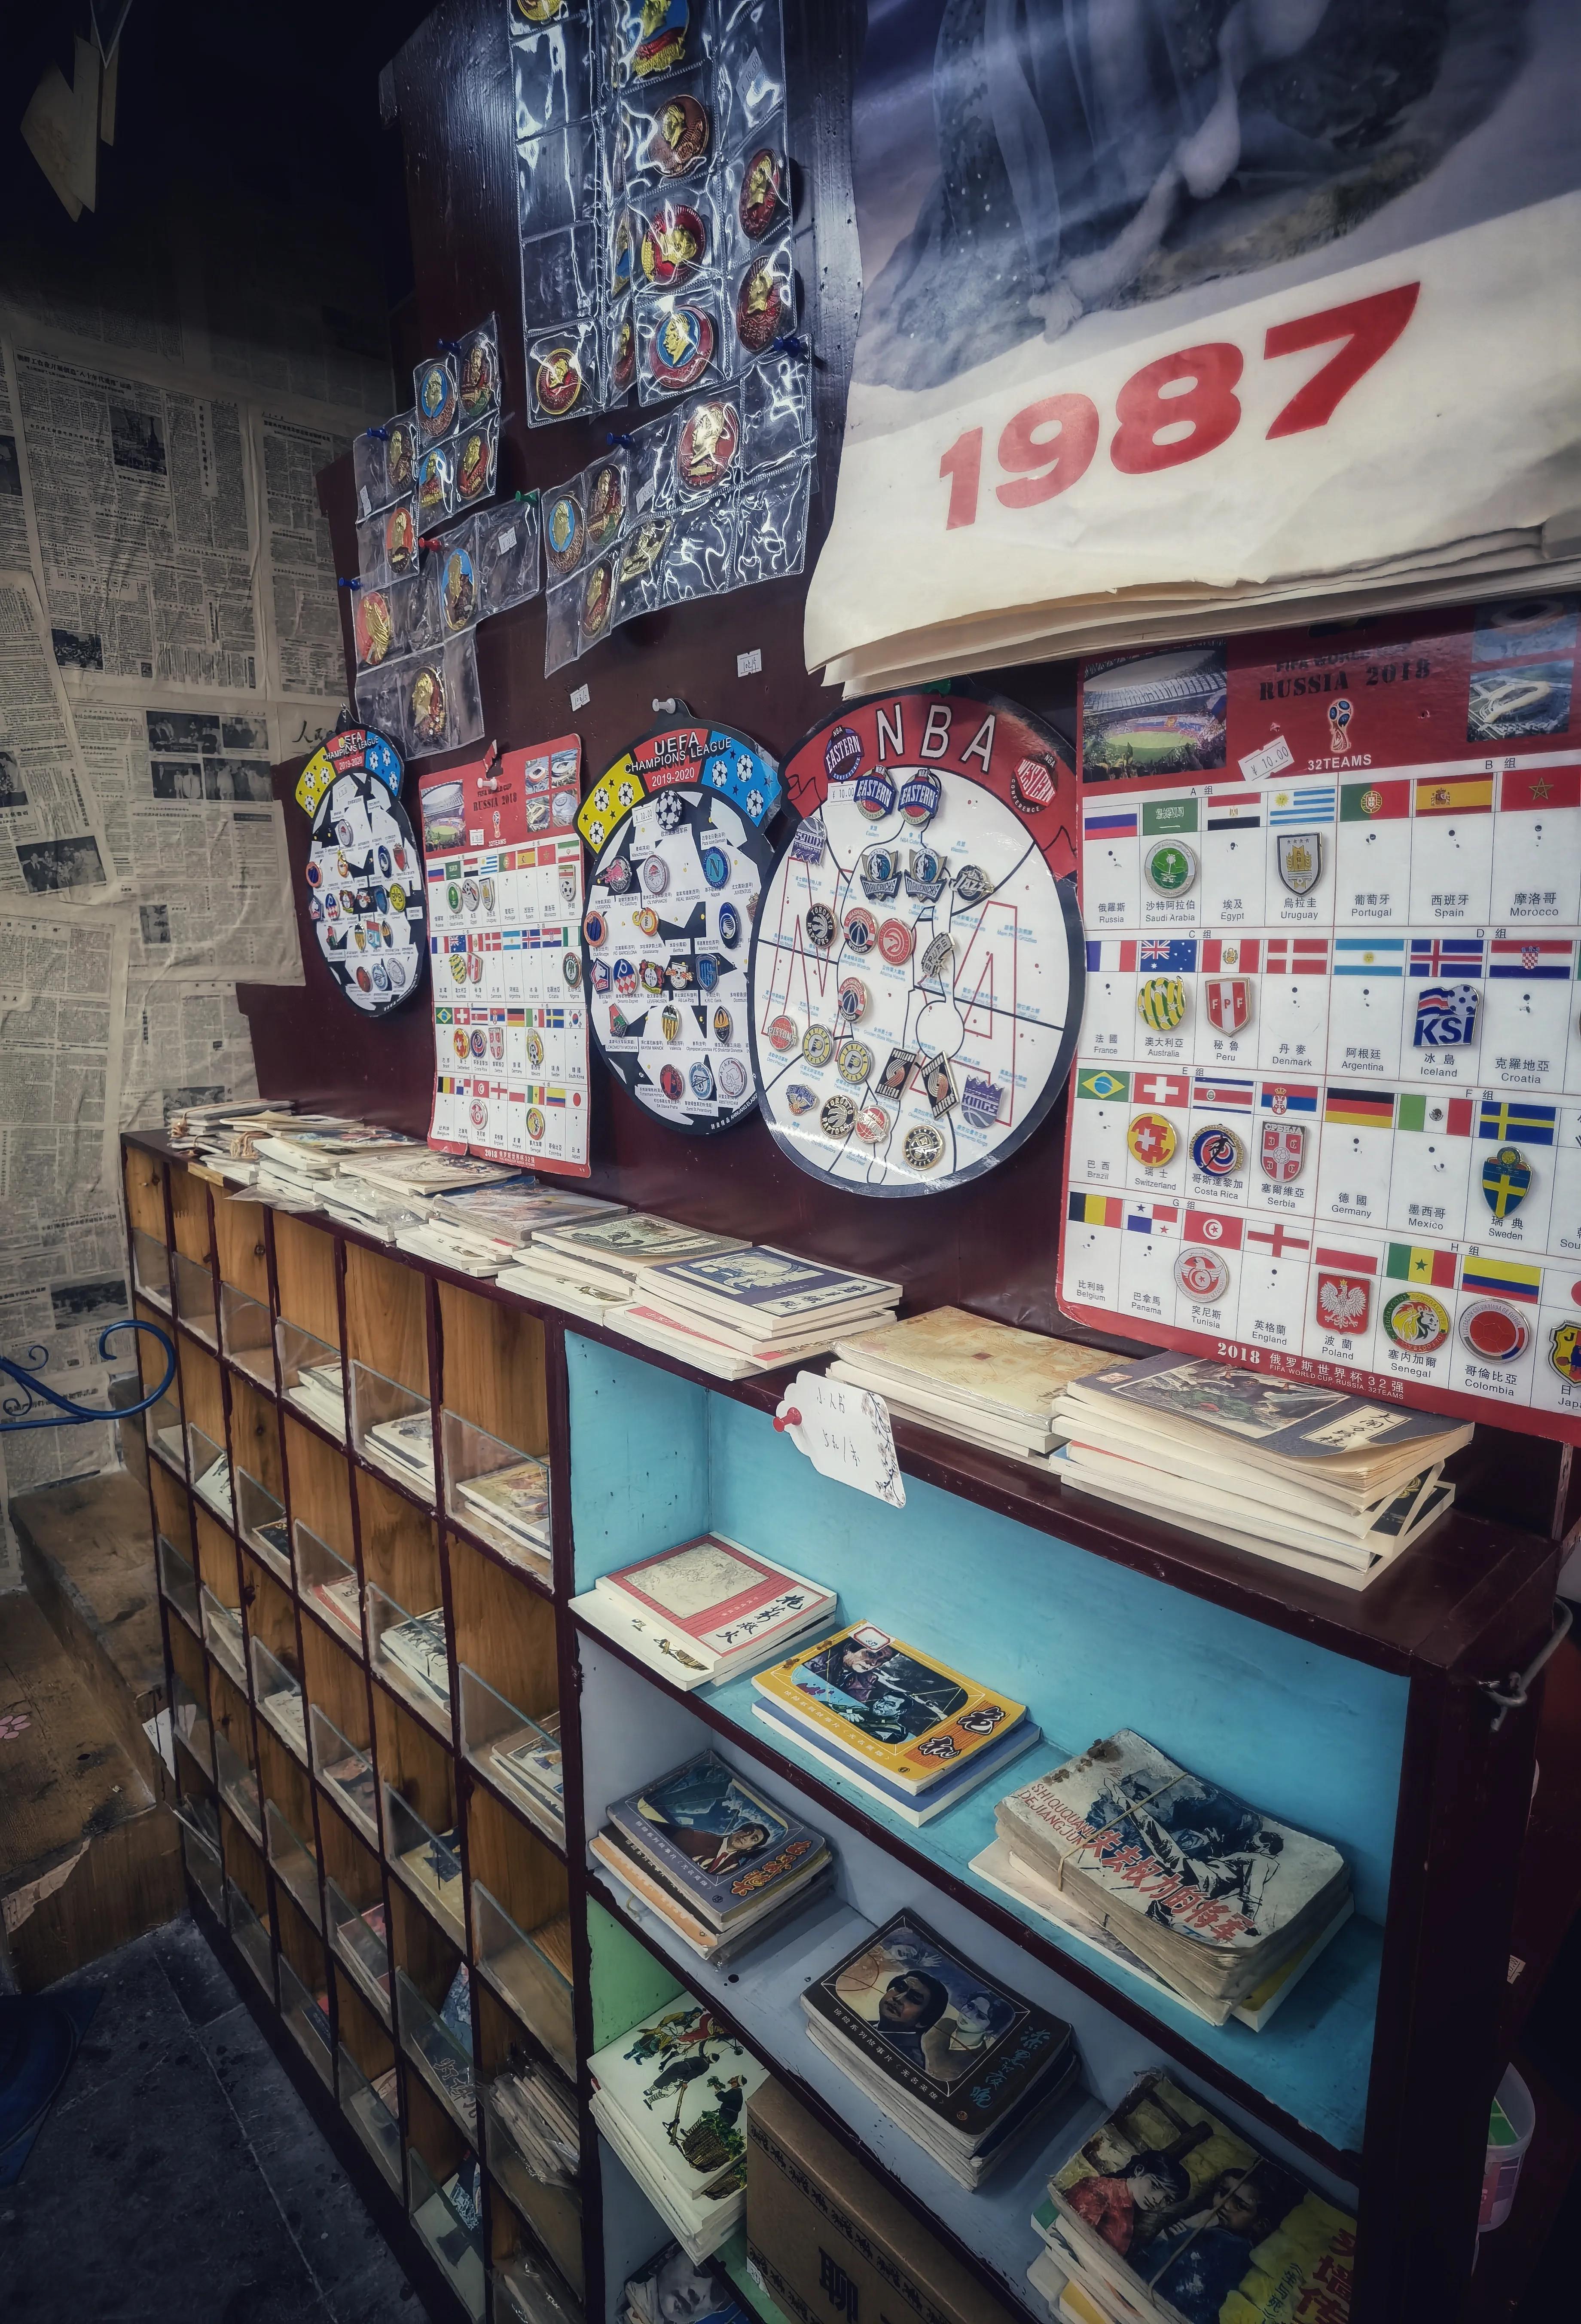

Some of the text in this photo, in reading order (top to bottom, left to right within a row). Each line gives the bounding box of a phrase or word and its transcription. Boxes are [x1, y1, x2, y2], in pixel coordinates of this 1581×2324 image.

[939, 281, 1420, 532] 1987
[1260, 657, 1431, 700] RUSSIA 2018
[833, 727, 842, 737] NBA
[876, 703, 995, 772] NBA
[338, 731, 362, 749] UEFA
[359, 735, 379, 750] LEAGUE
[654, 731, 699, 755] UEFA
[624, 737, 732, 774] CHAMPIONS LEAGUE
[825, 735, 861, 774] EASTERN
[1044, 754, 1056, 768] NBA
[1263, 745, 1289, 766] 10.00
[876, 765, 885, 775] NBA
[1307, 754, 1372, 771] 32TEAMS
[652, 767, 695, 787] 2019-2020
[1017, 759, 1056, 803] WESTERN
[501, 792, 517, 805] 2018
[839, 787, 855, 798] 10.00
[857, 779, 892, 807] EASTERN
[901, 784, 936, 807] EASTERN
[1010, 779, 1040, 813] CONFERENCE
[708, 856, 722, 878] N
[863, 879, 897, 894] MAVERICKS
[906, 876, 942, 898] MAVERICKS
[950, 872, 985, 892] JAZZ
[811, 906, 833, 930] TORONTO
[1221, 912, 1244, 921] Egypt
[1281, 911, 1318, 920] Uruguay
[1352, 908, 1391, 917] Portugal
[1435, 909, 1463, 918] Spain
[1511, 908, 1558, 916] Morocco
[807, 922, 829, 945] RAPTORS
[1212, 997, 1244, 1010] FPF
[1414, 1016, 1474, 1046] KSI
[719, 1059, 731, 1076] AJAX
[1273, 1057, 1312, 1066] Denmark
[1342, 1061, 1383, 1071] Argentina
[1421, 1067, 1457, 1076] Iceland
[1502, 1073, 1541, 1083] Croatia
[825, 1098, 854, 1115] TORONTO
[964, 1095, 998, 1113] KINGS
[485, 1149, 497, 1159] 2018
[1087, 1171, 1108, 1179] Brazil
[1135, 1178, 1176, 1190] Switzerland
[1195, 1187, 1238, 1199] Costa Rica
[1268, 1198, 1295, 1208] Serbia
[1332, 1205, 1371, 1218] Germany
[1409, 1218, 1443, 1229] Mexico
[1489, 1227, 1522, 1240] Sweden
[1077, 1288, 1105, 1301] Belgium
[1132, 1300, 1161, 1315] Panama
[1192, 1314, 1221, 1329] Tunisia
[1253, 1329, 1286, 1345] England
[1218, 1342, 1260, 1364] 2018
[1322, 1345, 1353, 1360] Poland
[1389, 1361, 1433, 1380] Senegal
[1270, 1364, 1285, 1372] FIFA
[1288, 1367, 1315, 1381] WORLD
[1368, 1385, 1404, 1400] 32TEAMS
[1463, 1377, 1516, 1398] Colombia
[1083, 1829, 1254, 1945] 失去权力的将军
